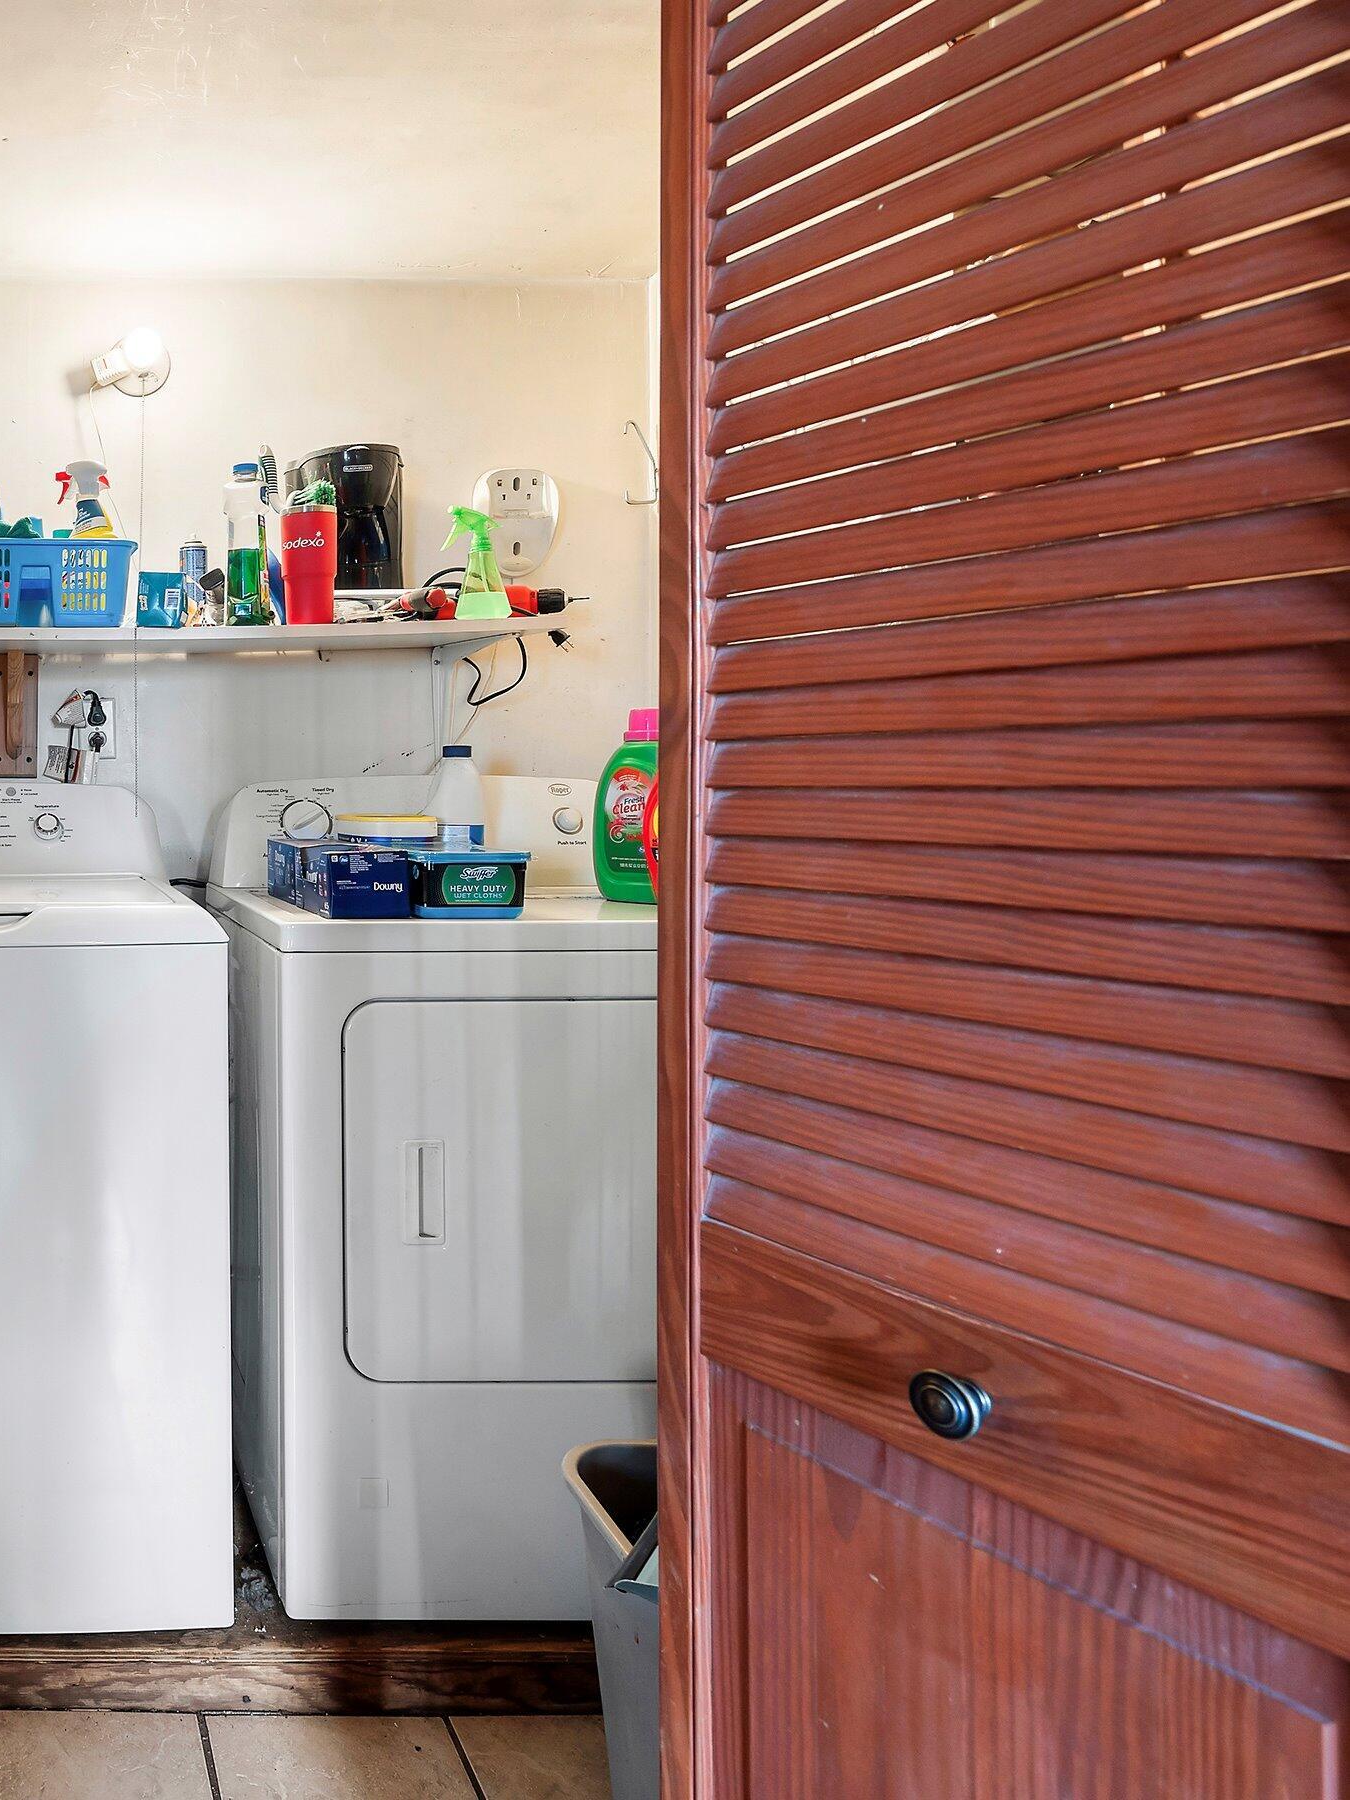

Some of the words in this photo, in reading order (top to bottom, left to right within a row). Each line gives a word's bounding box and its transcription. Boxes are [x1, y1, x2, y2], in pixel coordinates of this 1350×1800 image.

[282, 536, 325, 551] sodexo
[623, 795, 645, 806] Fresh
[612, 802, 646, 816] Clean
[460, 866, 499, 882] Swiffer
[373, 881, 403, 892] Downy
[449, 885, 480, 893] HEAVY
[482, 885, 508, 893] DUTY
